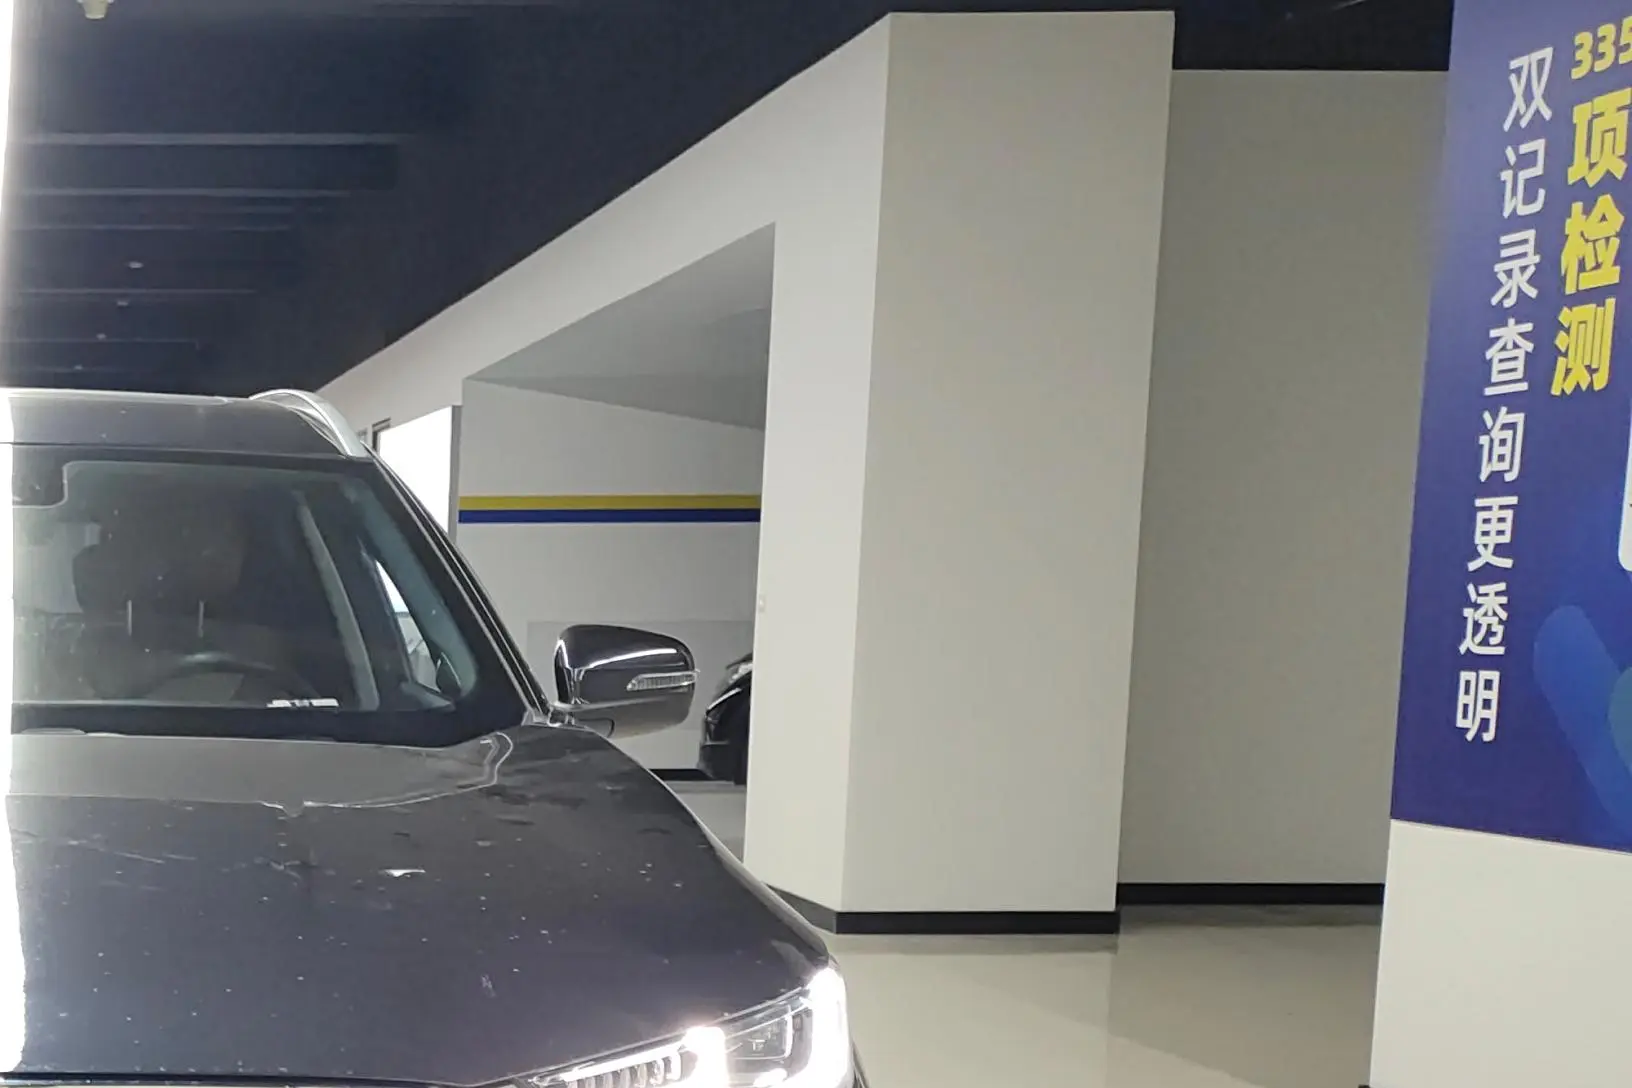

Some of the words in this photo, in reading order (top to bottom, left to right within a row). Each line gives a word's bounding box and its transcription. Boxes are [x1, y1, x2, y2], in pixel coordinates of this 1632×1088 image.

[1455, 47, 1553, 742] 双记录查询更透明
